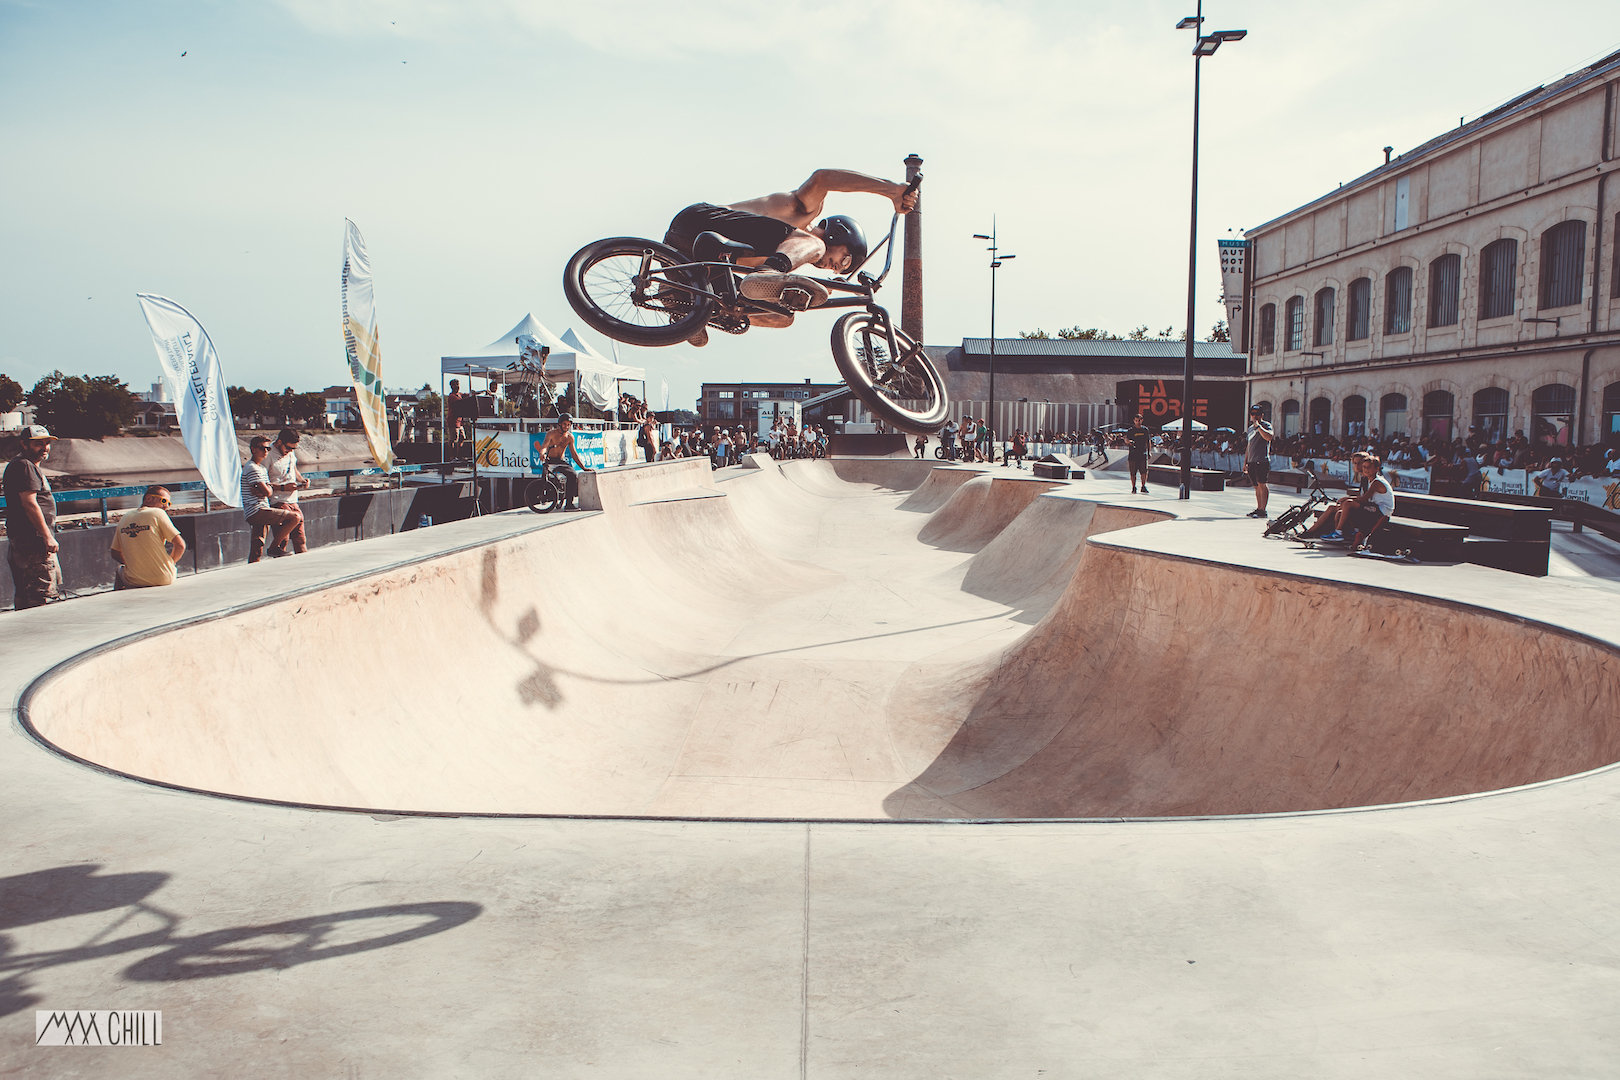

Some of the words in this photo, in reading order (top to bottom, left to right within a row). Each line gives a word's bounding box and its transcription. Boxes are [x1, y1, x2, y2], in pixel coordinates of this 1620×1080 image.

[1222, 266, 1243, 274] VÉL
[1139, 380, 1167, 397] LA
[486, 448, 530, 468] Châte
